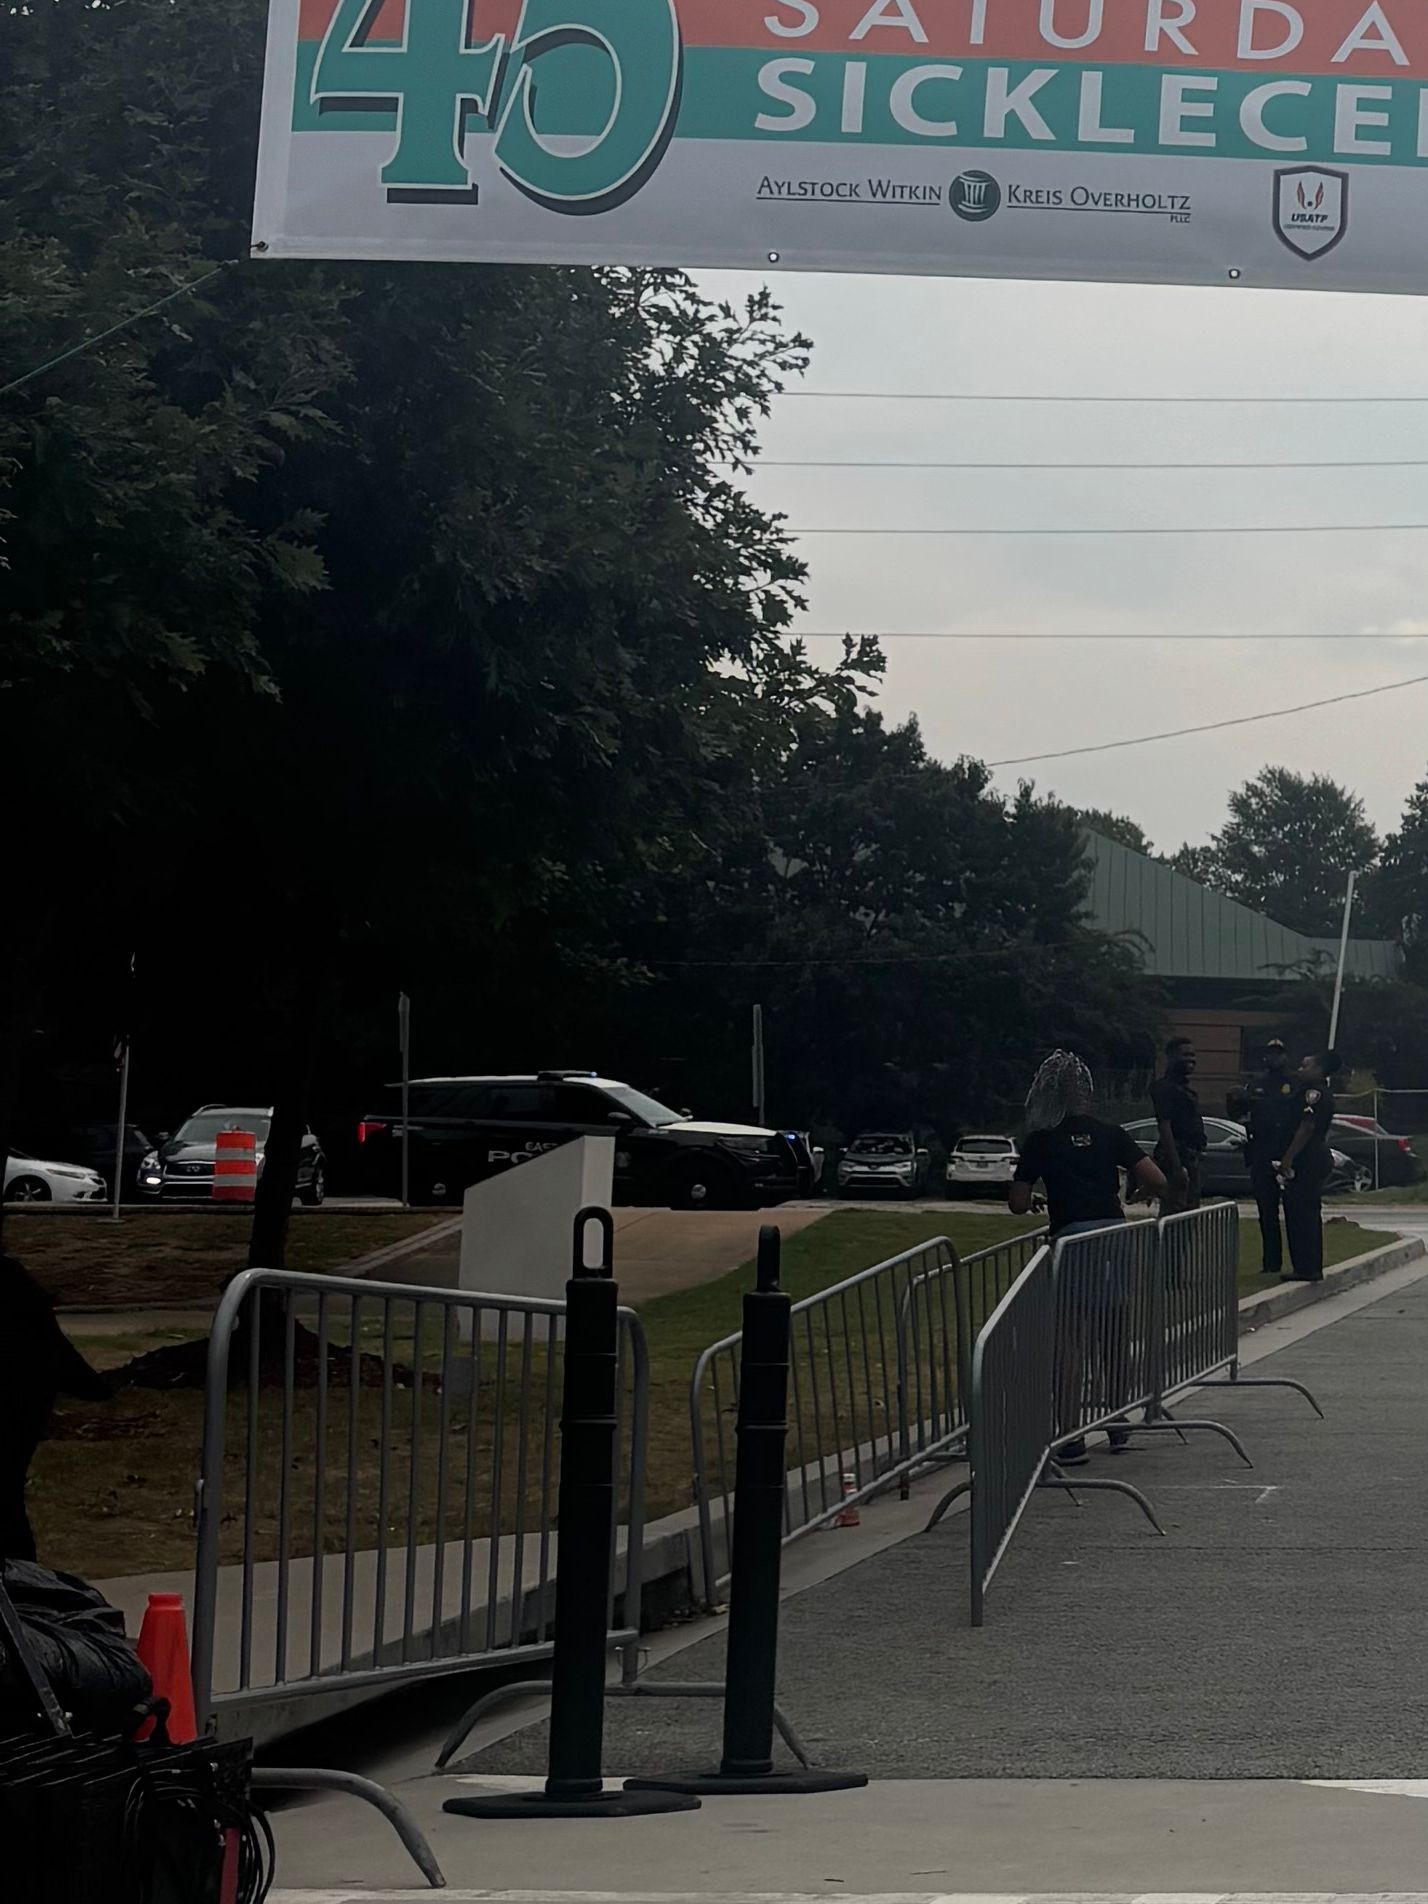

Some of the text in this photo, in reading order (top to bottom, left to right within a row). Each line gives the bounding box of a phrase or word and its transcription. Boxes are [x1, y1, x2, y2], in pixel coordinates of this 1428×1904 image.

[756, 176, 943, 202] AYLSTOCK WITKIN
[1007, 184, 1192, 211] KREIS OVERHOLTZ
